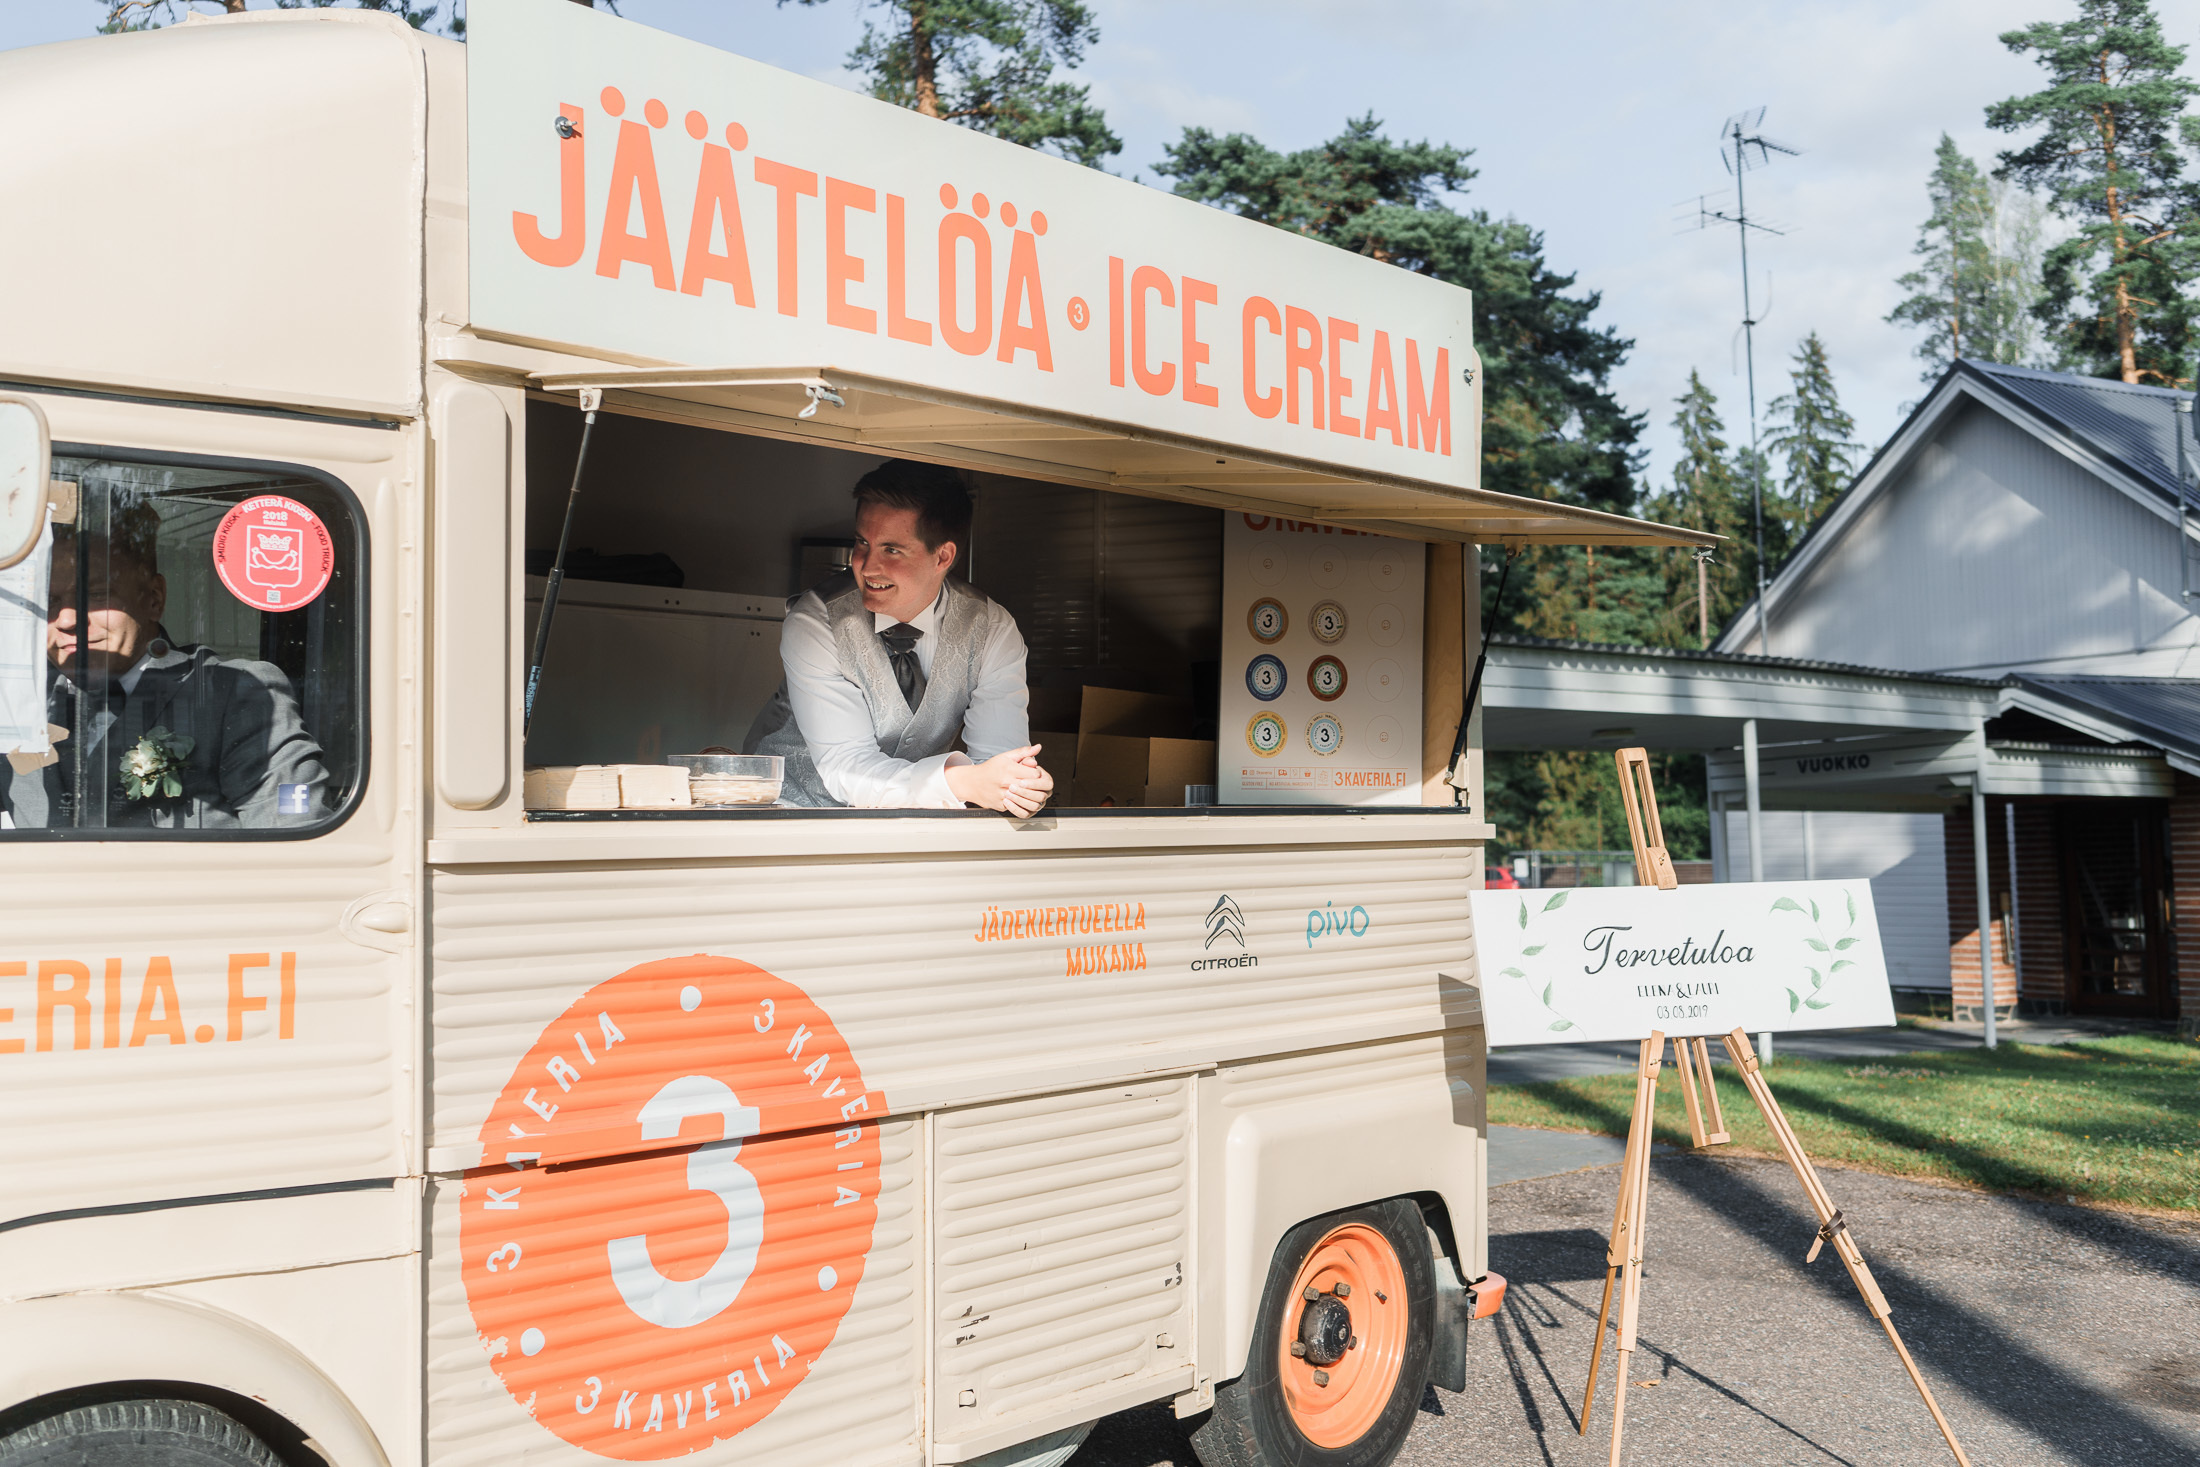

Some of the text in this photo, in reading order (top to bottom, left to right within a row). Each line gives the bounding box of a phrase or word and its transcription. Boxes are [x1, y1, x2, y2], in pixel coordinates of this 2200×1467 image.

[512, 85, 1055, 373] JÄÄTELÖÄ
[1108, 255, 1219, 408] ICE
[1242, 295, 1452, 457] CREAM
[241, 497, 314, 522] KETTERÄ KIOSKI
[262, 510, 288, 521] 2018
[221, 512, 240, 535] KIOSK
[314, 525, 331, 573] FOOD TRUCK
[1262, 613, 1273, 628] 3
[1324, 615, 1334, 630] 3
[1261, 670, 1272, 685] 3
[1322, 671, 1332, 685] 3
[1262, 727, 1272, 742] 3
[1320, 728, 1330, 743] 3
[1796, 754, 1870, 774] VUOKKO
[1334, 771, 1406, 787] 3KAVERIA.FI
[974, 901, 1146, 943] JÄDEKIERTUEELLA
[1306, 900, 1370, 948] pivo
[1065, 942, 1147, 977] MUKANA
[1190, 953, 1258, 972] CITROËN
[1583, 926, 1757, 975] Tervetuloa
[0, 951, 296, 1055] ERIA.FI
[1656, 1004, 1708, 1019] 03.08.2019
[753, 998, 869, 1208] 3 KAVERIA
[483, 1011, 626, 1273] 3 KAVERIA
[607, 1074, 765, 1329] 3
[575, 1334, 796, 1433] 3 KAVERIA
